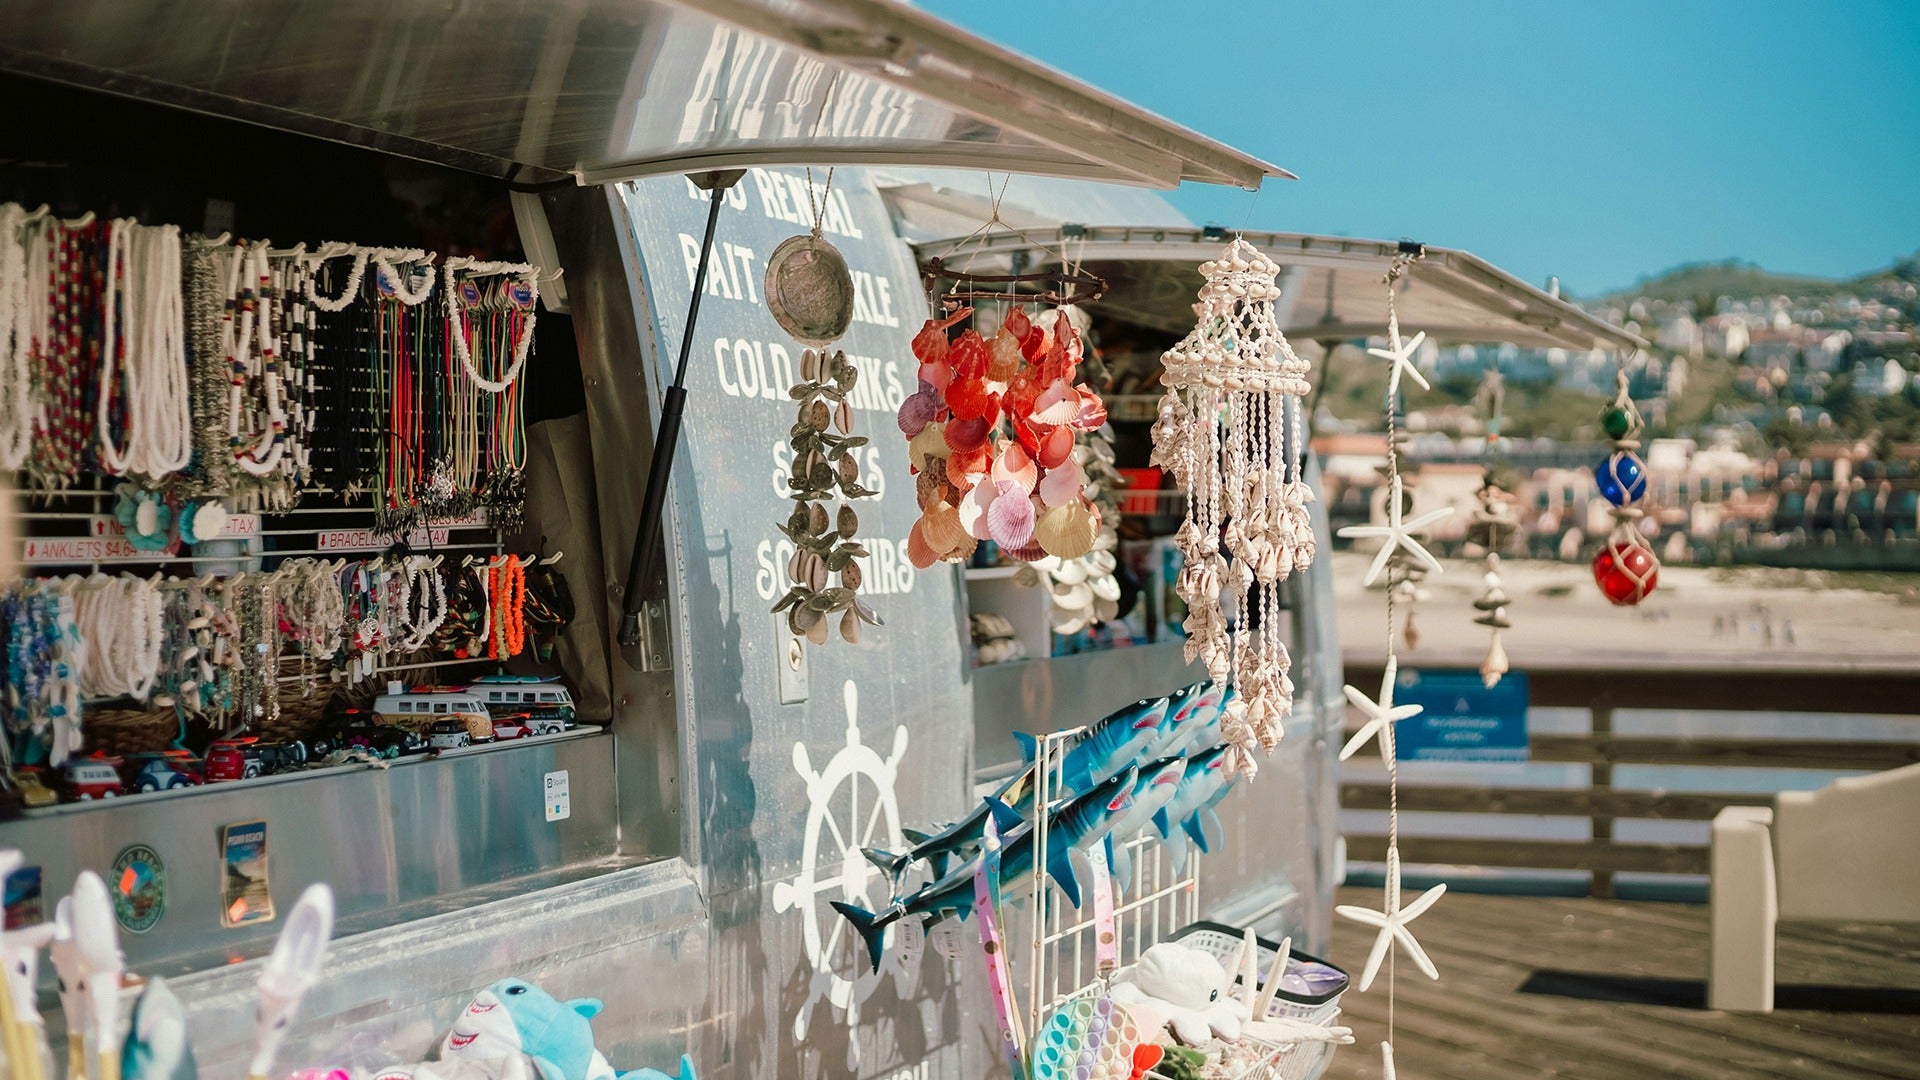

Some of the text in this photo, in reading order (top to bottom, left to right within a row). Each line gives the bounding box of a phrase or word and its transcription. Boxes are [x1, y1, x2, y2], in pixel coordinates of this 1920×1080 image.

[751, 167, 863, 240] RENTAL
[678, 233, 899, 328] BAIT KLE
[714, 337, 796, 402] COLD
[40, 539, 102, 558] ANKLETS
[756, 538, 914, 600] SONIRS
